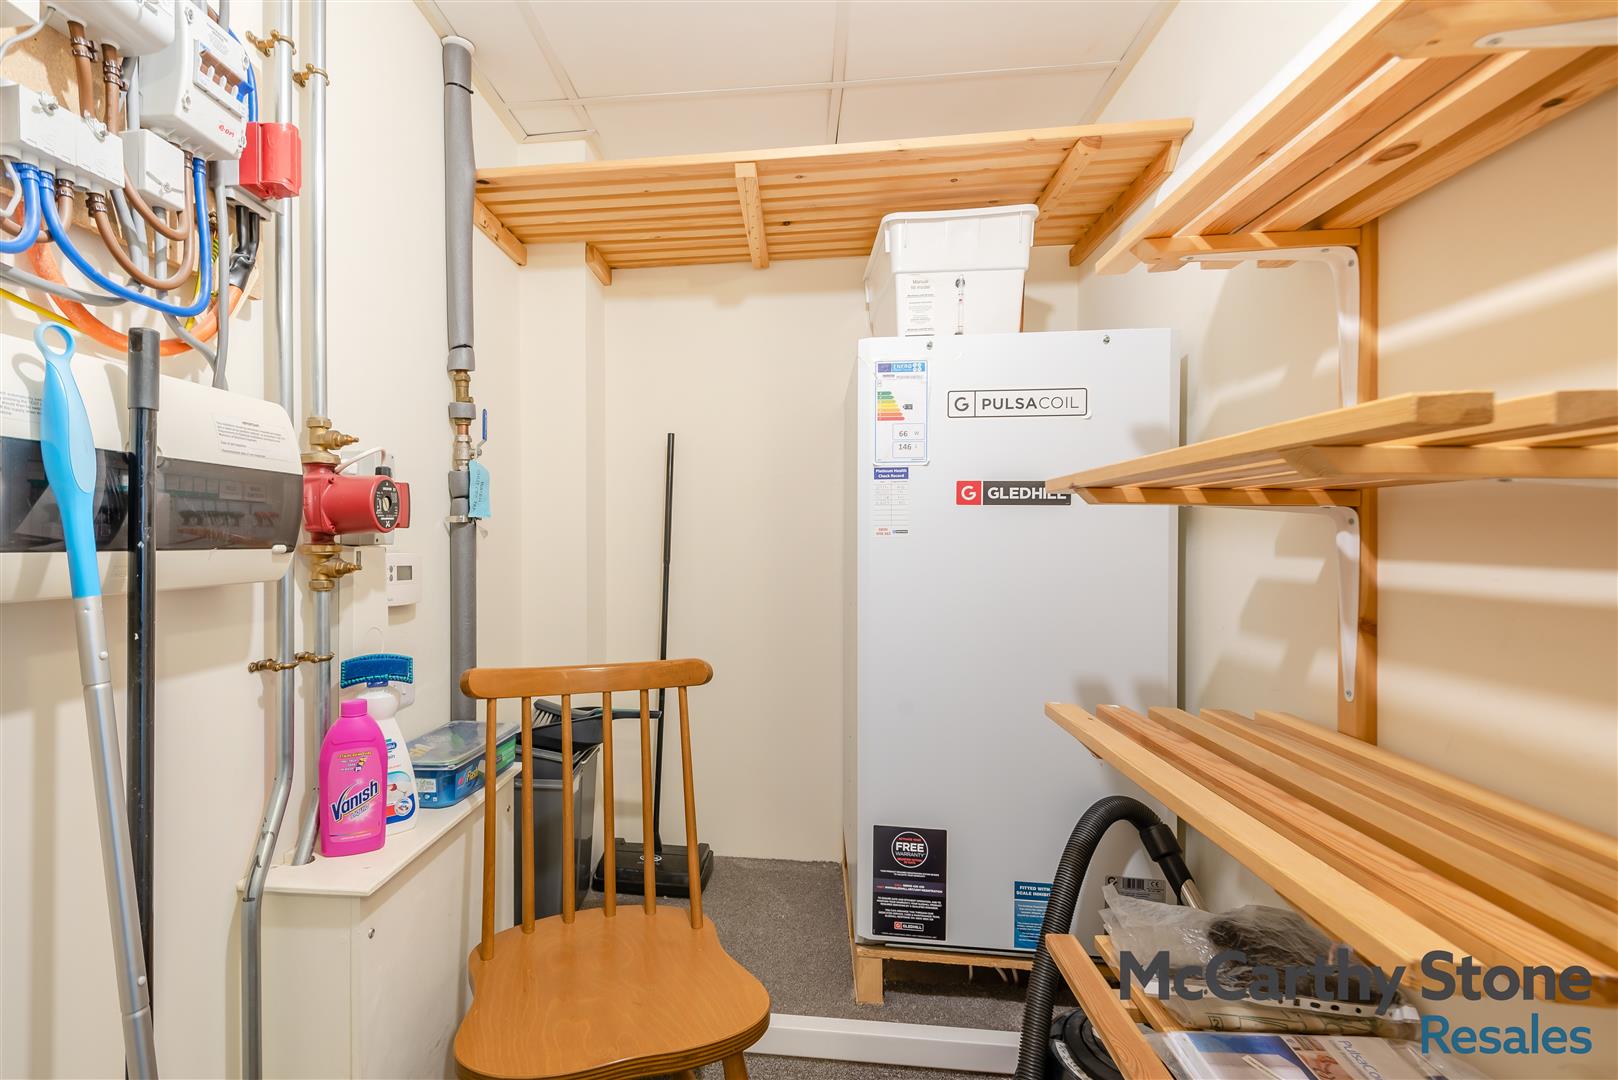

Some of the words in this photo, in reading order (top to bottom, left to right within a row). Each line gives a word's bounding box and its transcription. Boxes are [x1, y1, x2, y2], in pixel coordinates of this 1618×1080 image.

[982, 396, 1079, 410] PULSACOIL
[331, 780, 379, 822] Vanish
[895, 841, 925, 852] FREE
